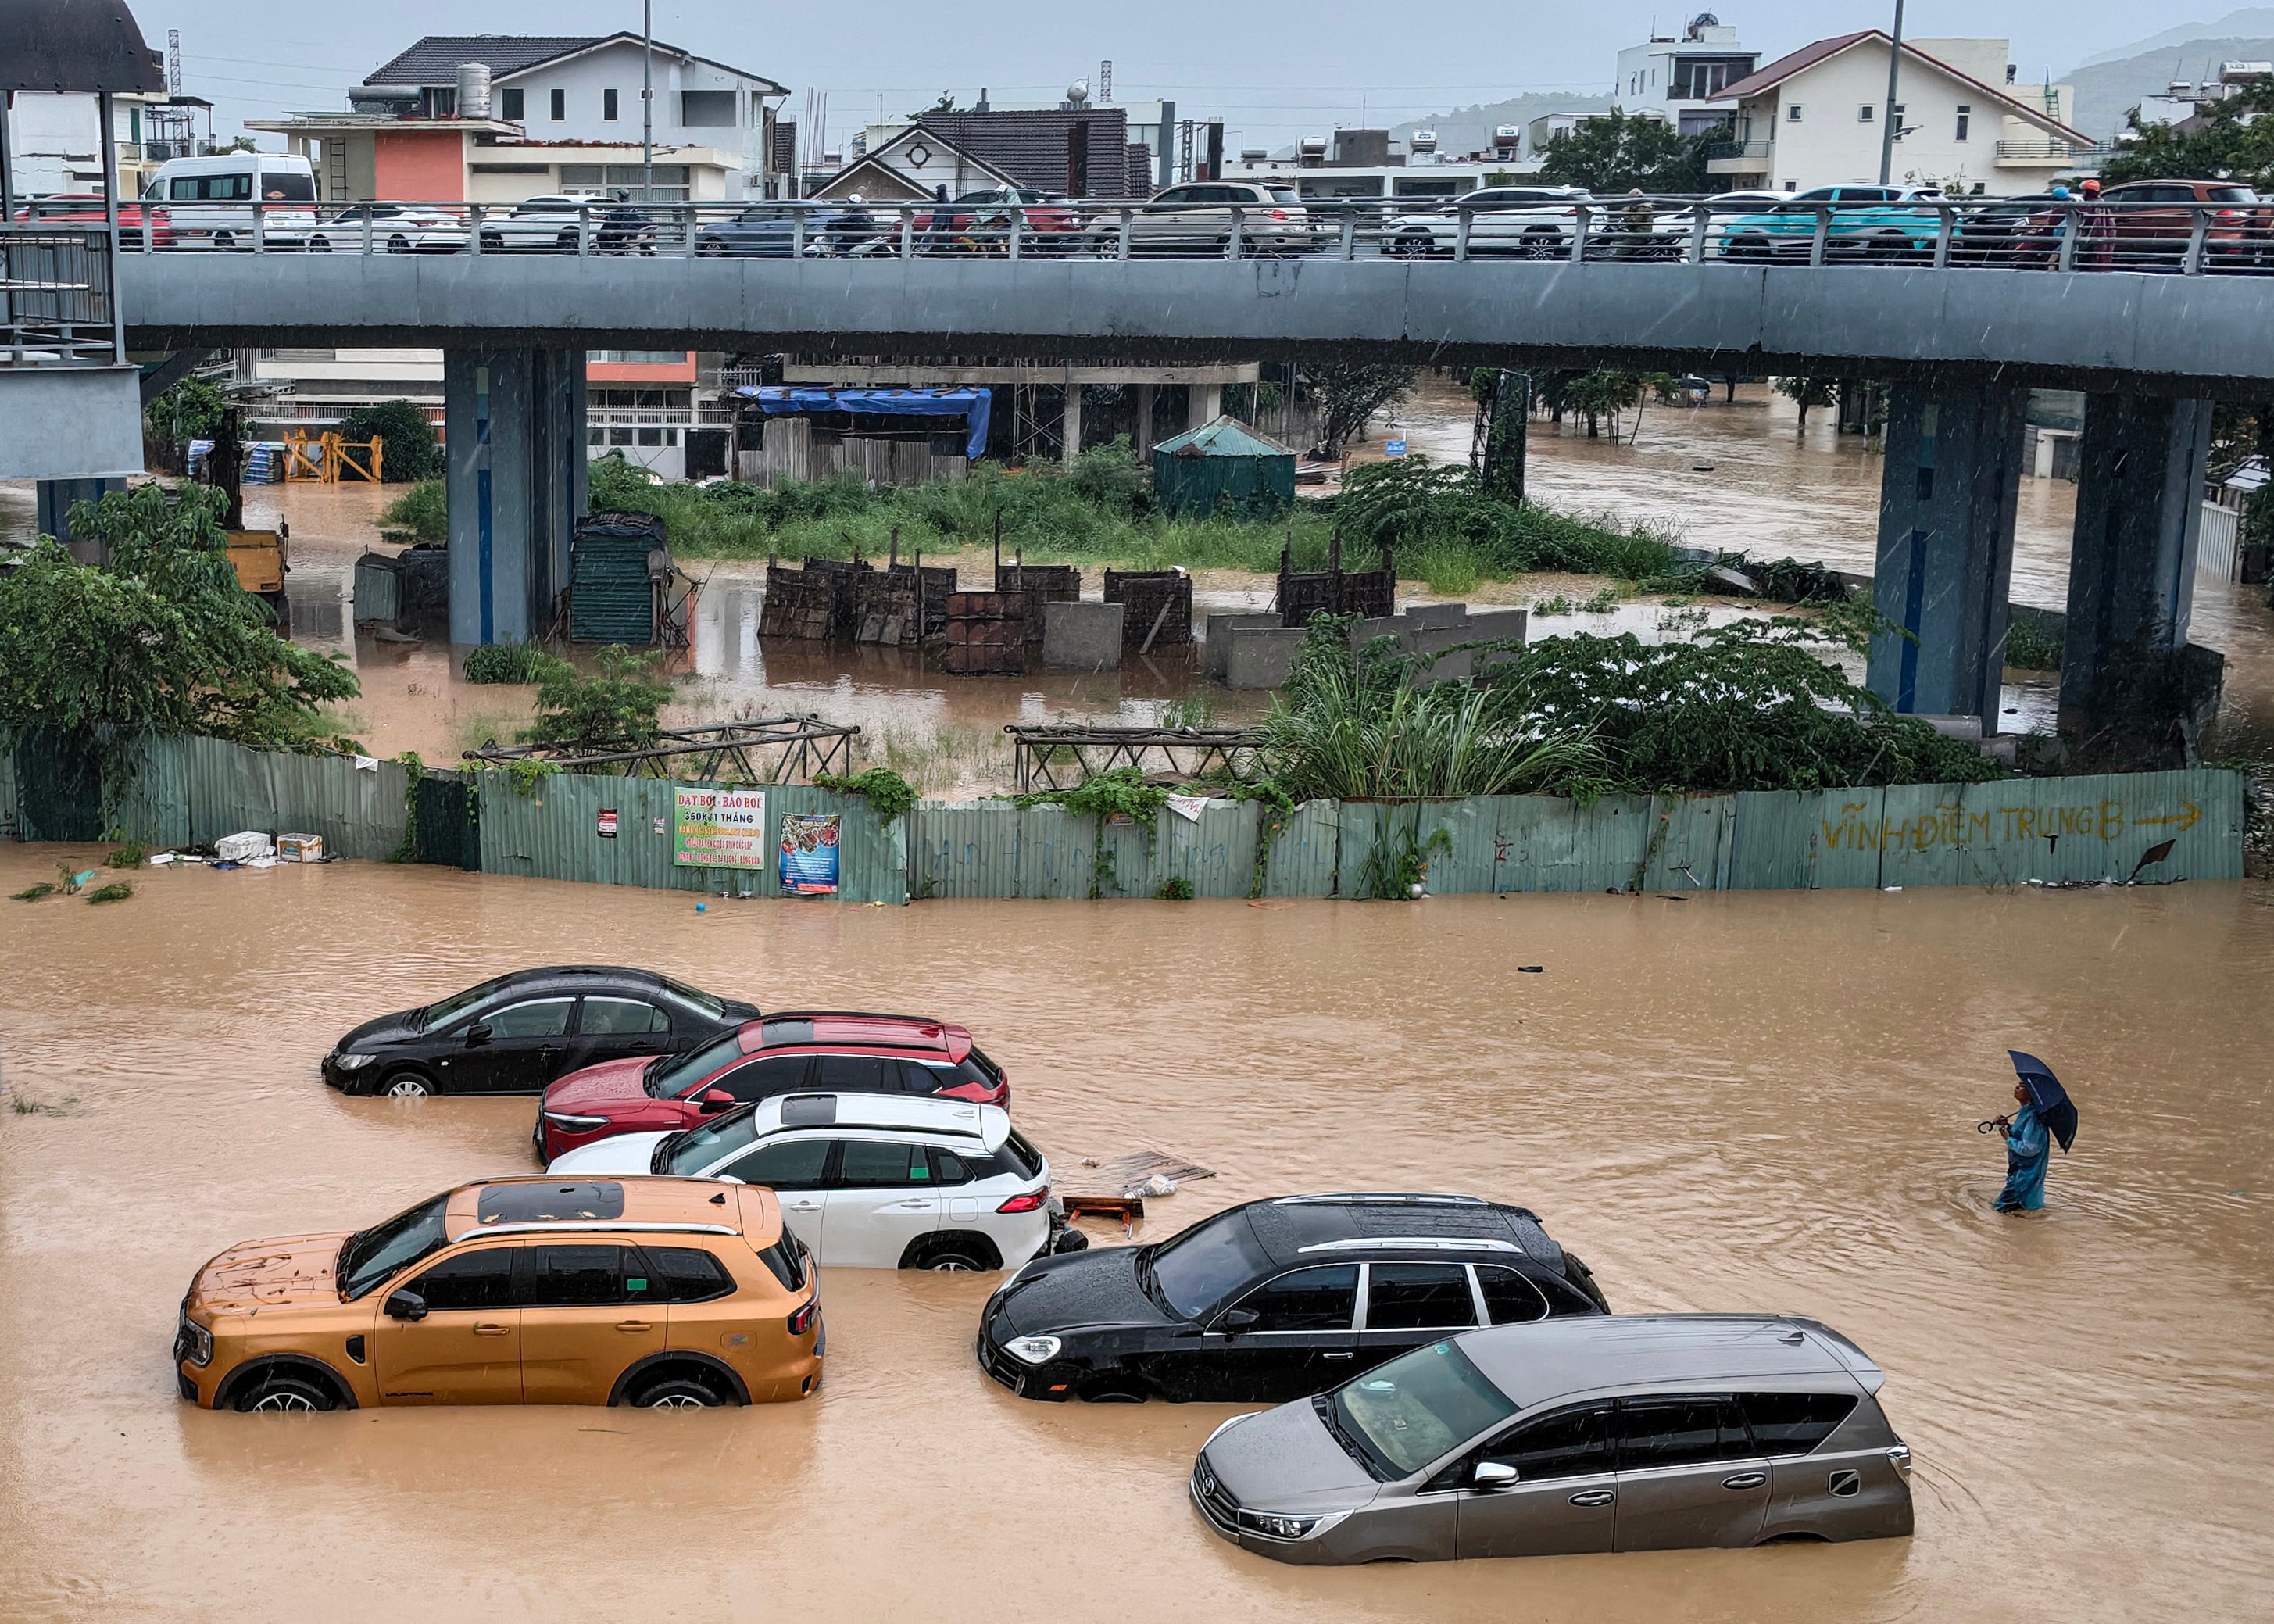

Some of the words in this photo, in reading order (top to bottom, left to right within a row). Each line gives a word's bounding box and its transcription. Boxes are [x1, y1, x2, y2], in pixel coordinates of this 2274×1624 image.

[723, 796, 742, 807] BAO
[721, 812, 754, 824] THÁNG
[1822, 802, 1908, 850] VĨNH
[1997, 806, 2094, 842] TRUNG
